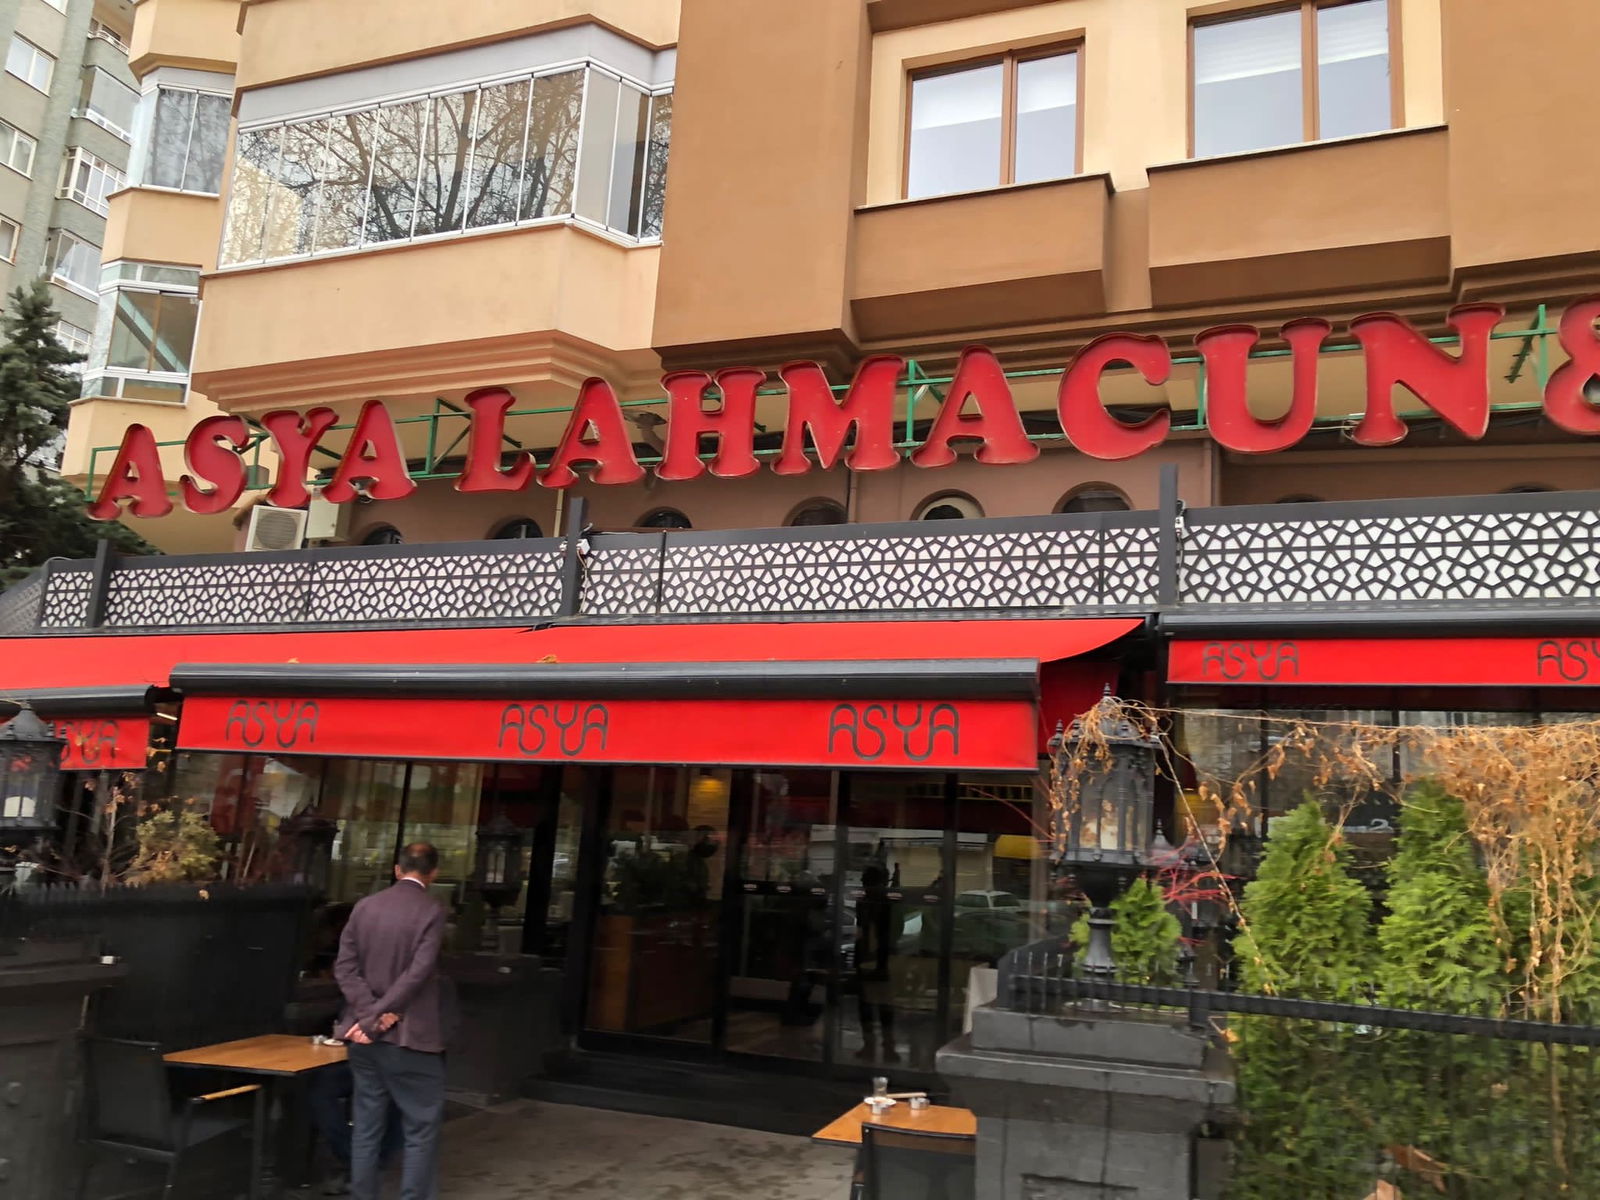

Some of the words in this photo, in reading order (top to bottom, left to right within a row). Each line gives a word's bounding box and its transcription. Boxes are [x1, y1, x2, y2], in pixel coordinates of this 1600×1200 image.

[87, 400, 416, 521] ASYA
[454, 303, 1506, 493] LAHMACUN
[1202, 640, 1299, 680] ASYA
[225, 699, 320, 748] ASYA
[498, 703, 609, 756] ASYA
[828, 703, 960, 761] ASYA
